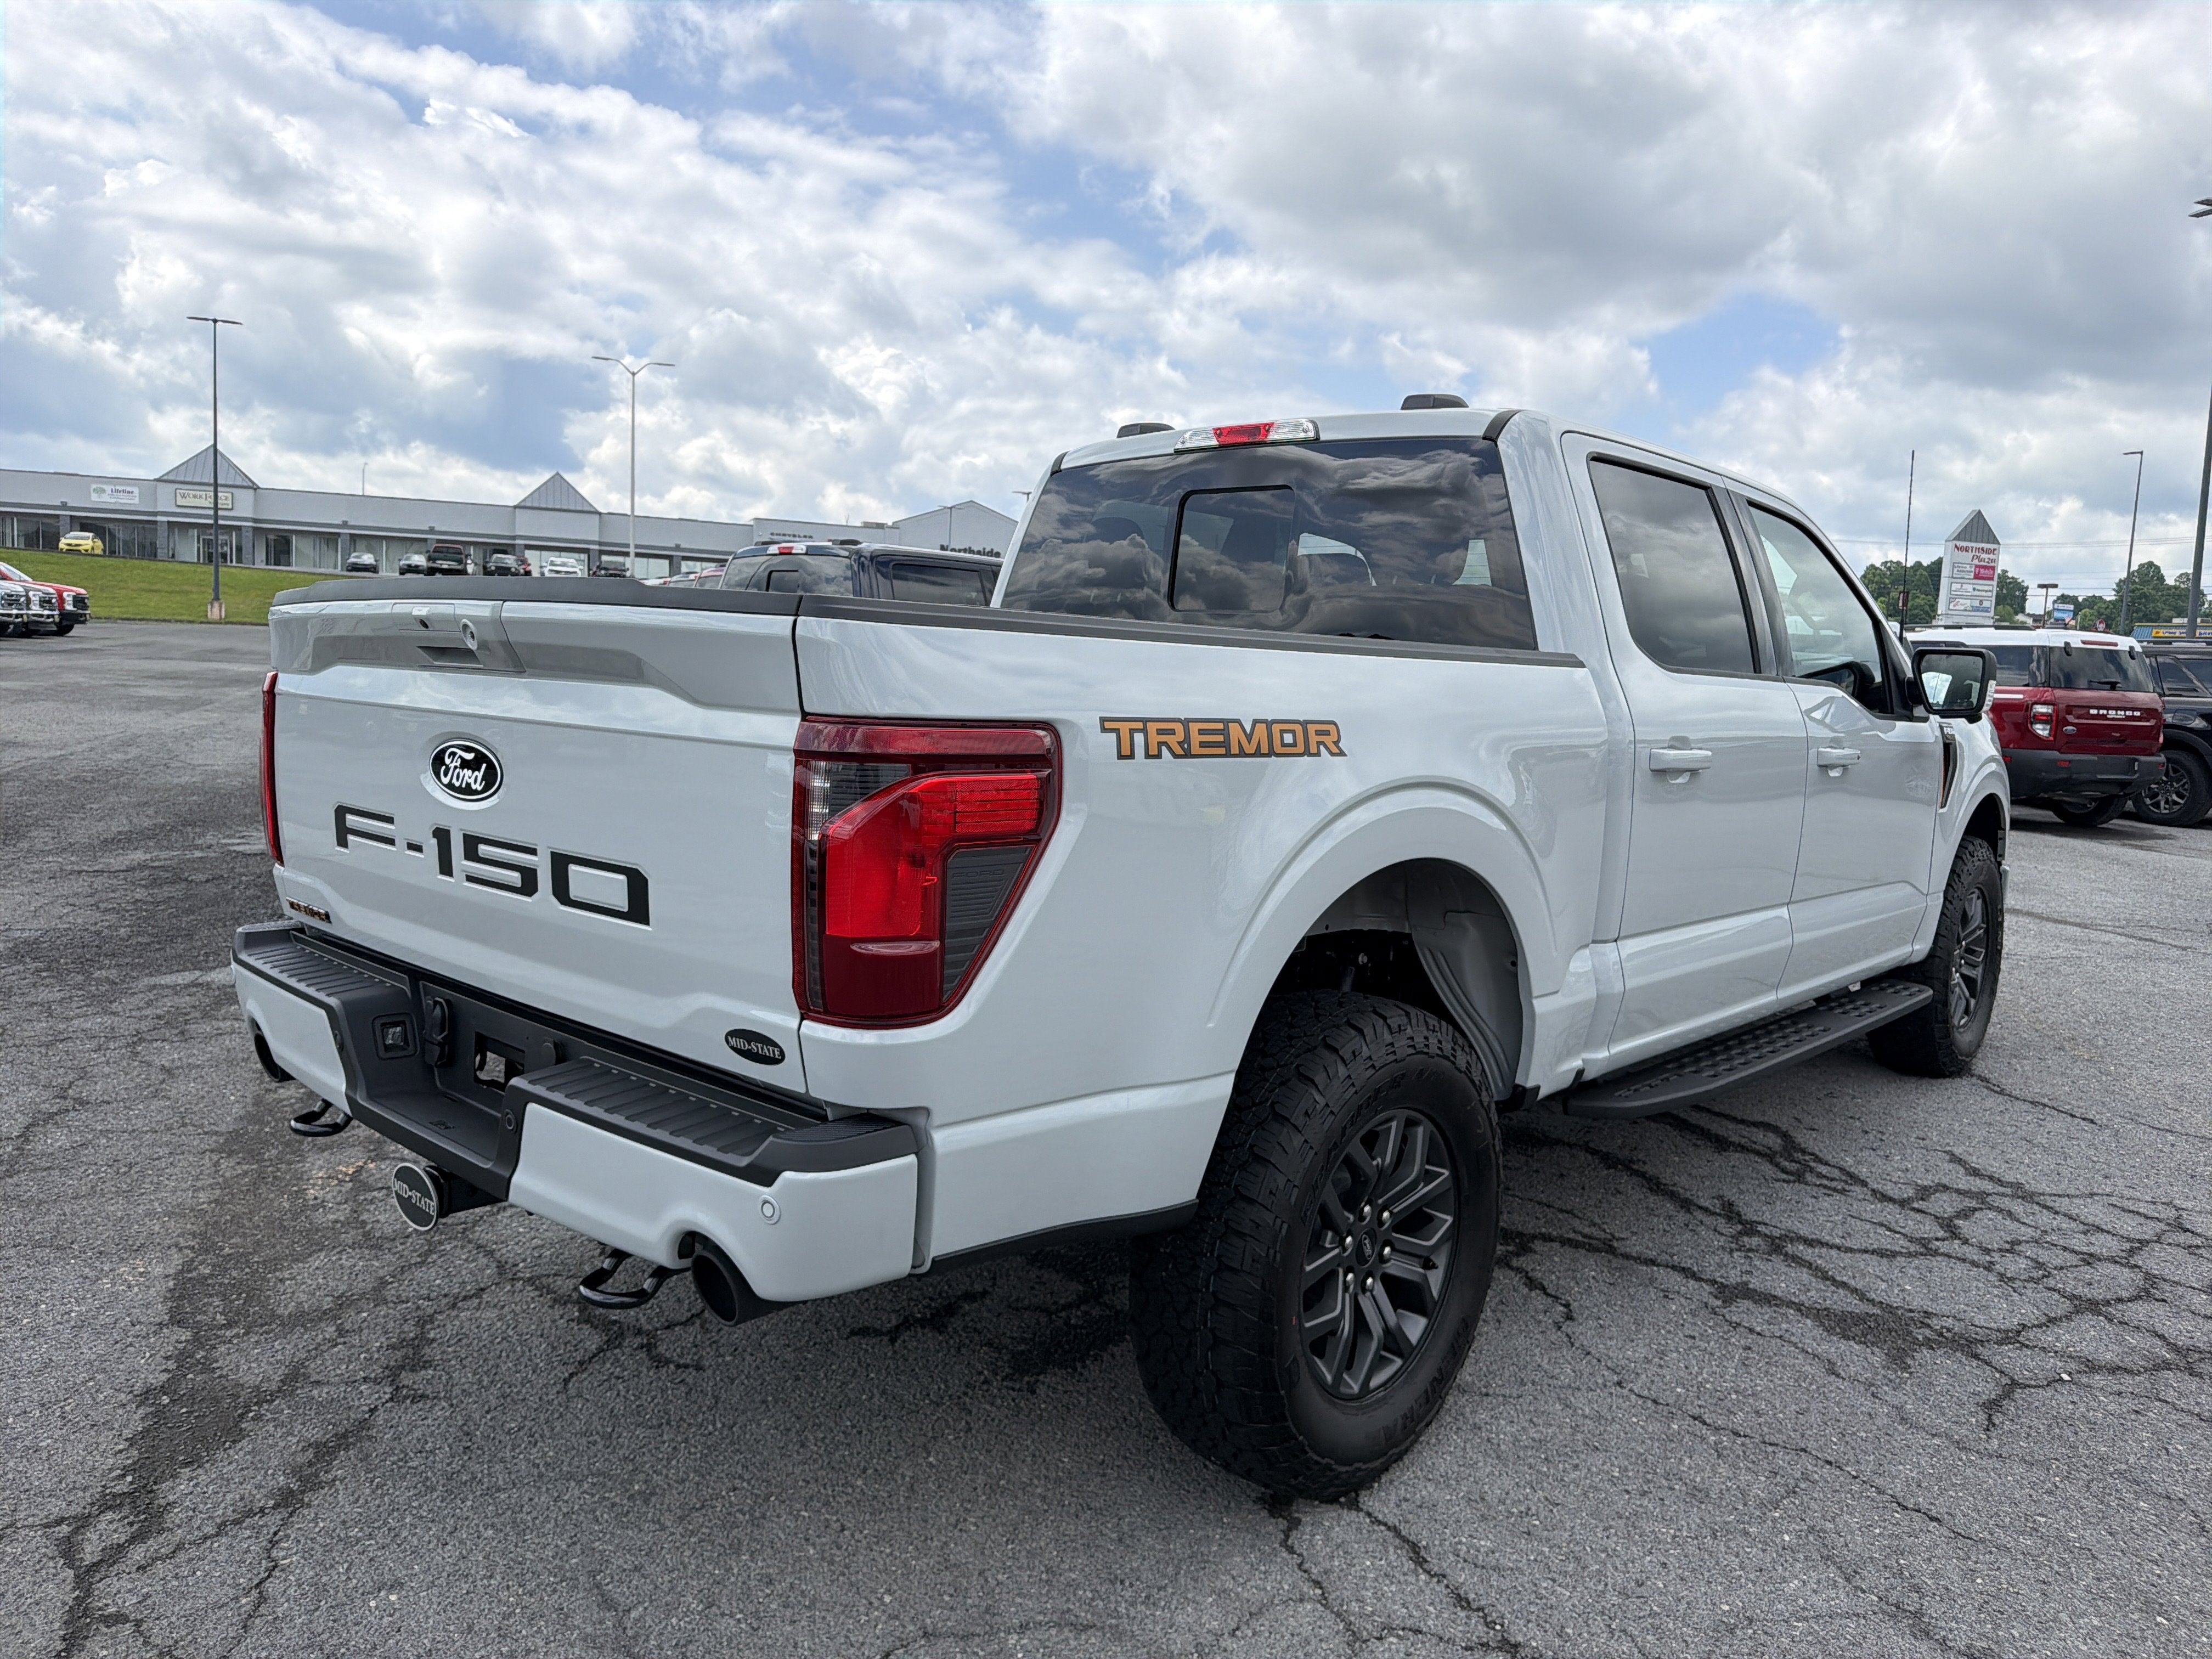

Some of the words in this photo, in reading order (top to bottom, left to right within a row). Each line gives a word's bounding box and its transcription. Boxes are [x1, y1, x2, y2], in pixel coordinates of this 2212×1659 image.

[940, 544, 1001, 558] Northside
[1954, 543, 1997, 555] NORTHSIDE
[1971, 554, 1996, 564] Plaza
[1099, 716, 1347, 760] TREMOR
[440, 747, 486, 791] Ford
[334, 804, 651, 927] F-150
[951, 868, 1005, 879] FORD
